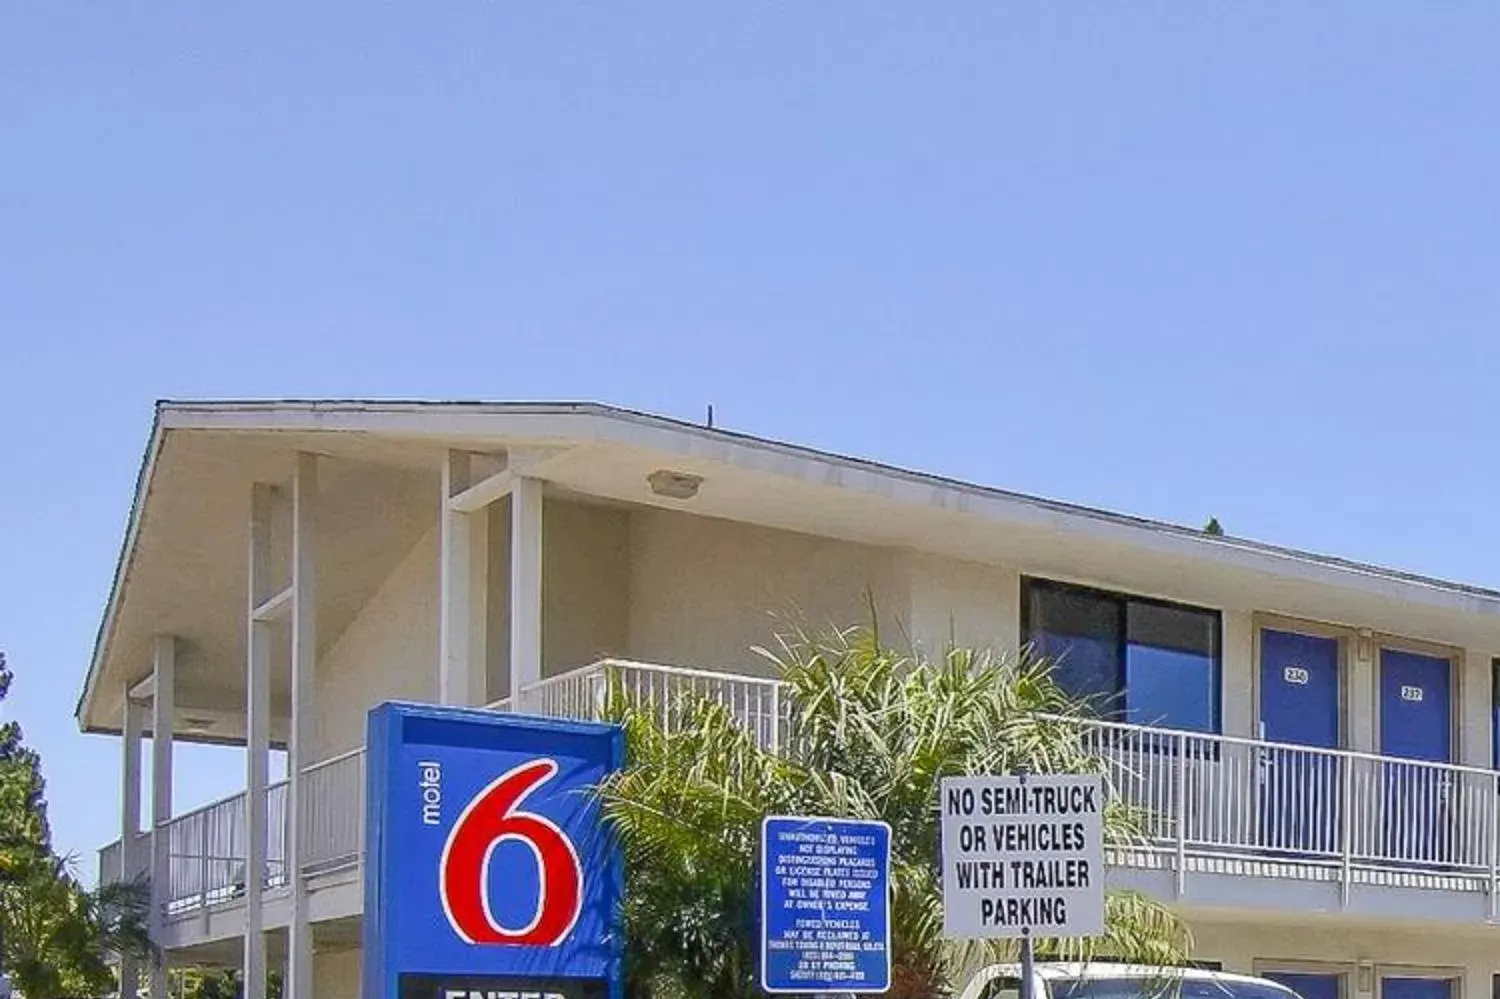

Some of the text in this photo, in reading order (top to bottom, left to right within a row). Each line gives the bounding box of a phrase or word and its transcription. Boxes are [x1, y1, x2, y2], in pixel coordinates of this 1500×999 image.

[419, 761, 440, 825] motel
[948, 786, 1096, 815] NO SEMI-TRUCK
[960, 823, 1085, 852] OR VEHICLES
[440, 757, 583, 947] 6
[799, 845, 813, 854] NOT
[775, 866, 787, 875] OR
[789, 867, 821, 876] LICENSE
[824, 868, 850, 877] PLATES
[956, 860, 1089, 888] WITH TRAILER
[782, 878, 872, 888] FOR DISABLED PERSONS
[788, 889, 807, 898] WILL
[809, 890, 819, 898] BE
[784, 900, 793, 908] AT
[982, 898, 1066, 925] PARKING
[825, 920, 860, 928] VEHICLES
[783, 930, 799, 939] MAY
